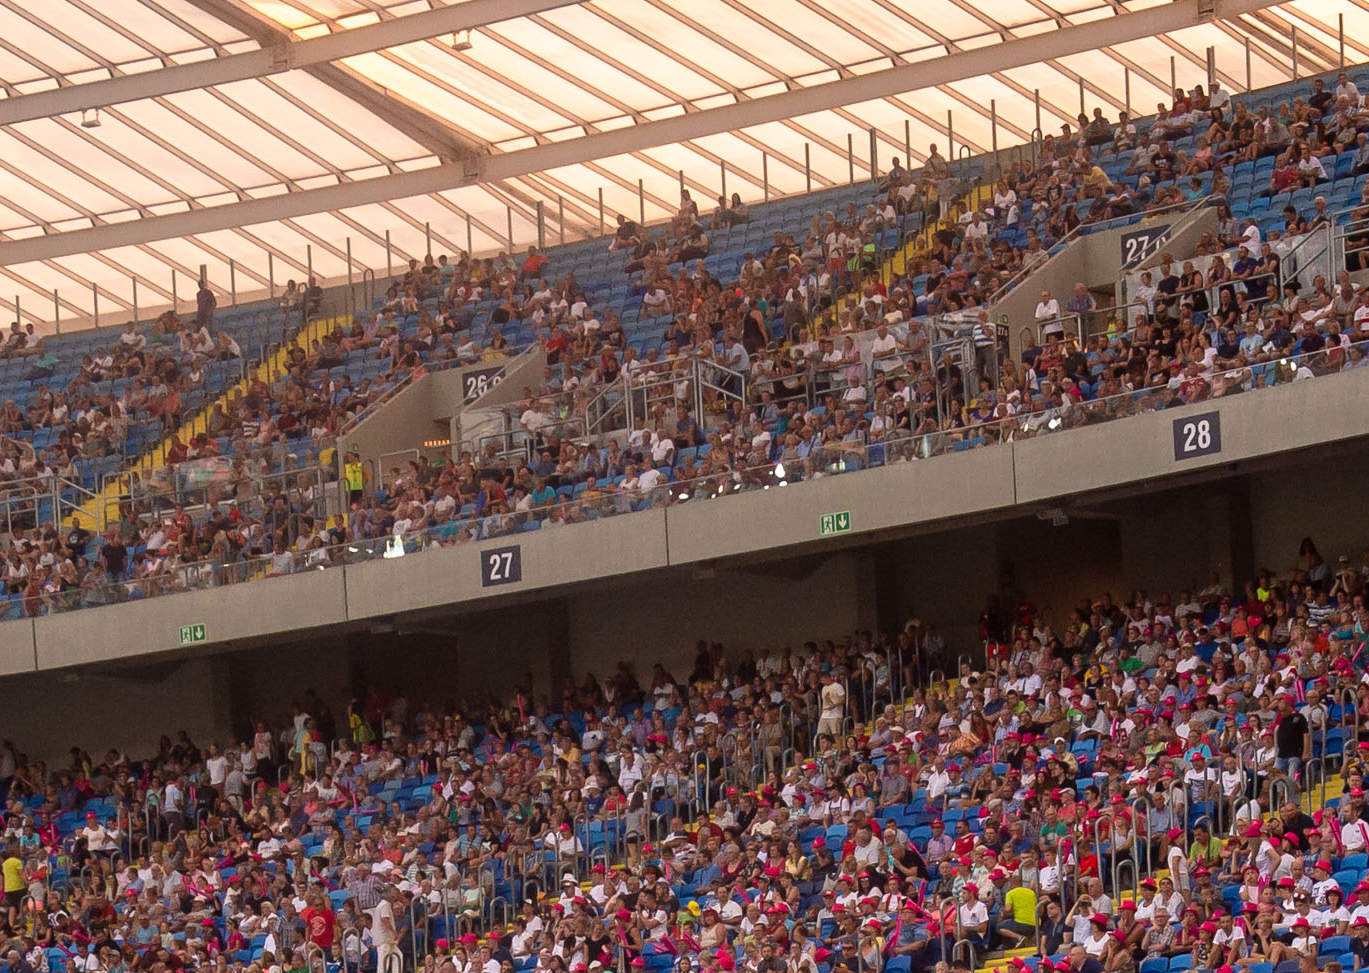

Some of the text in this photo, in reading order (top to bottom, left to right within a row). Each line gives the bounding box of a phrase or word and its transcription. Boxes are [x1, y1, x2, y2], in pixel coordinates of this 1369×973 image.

[1125, 235, 1150, 263] 27
[466, 375, 487, 398] 26
[1183, 420, 1211, 452] 28
[490, 553, 513, 580] 27
